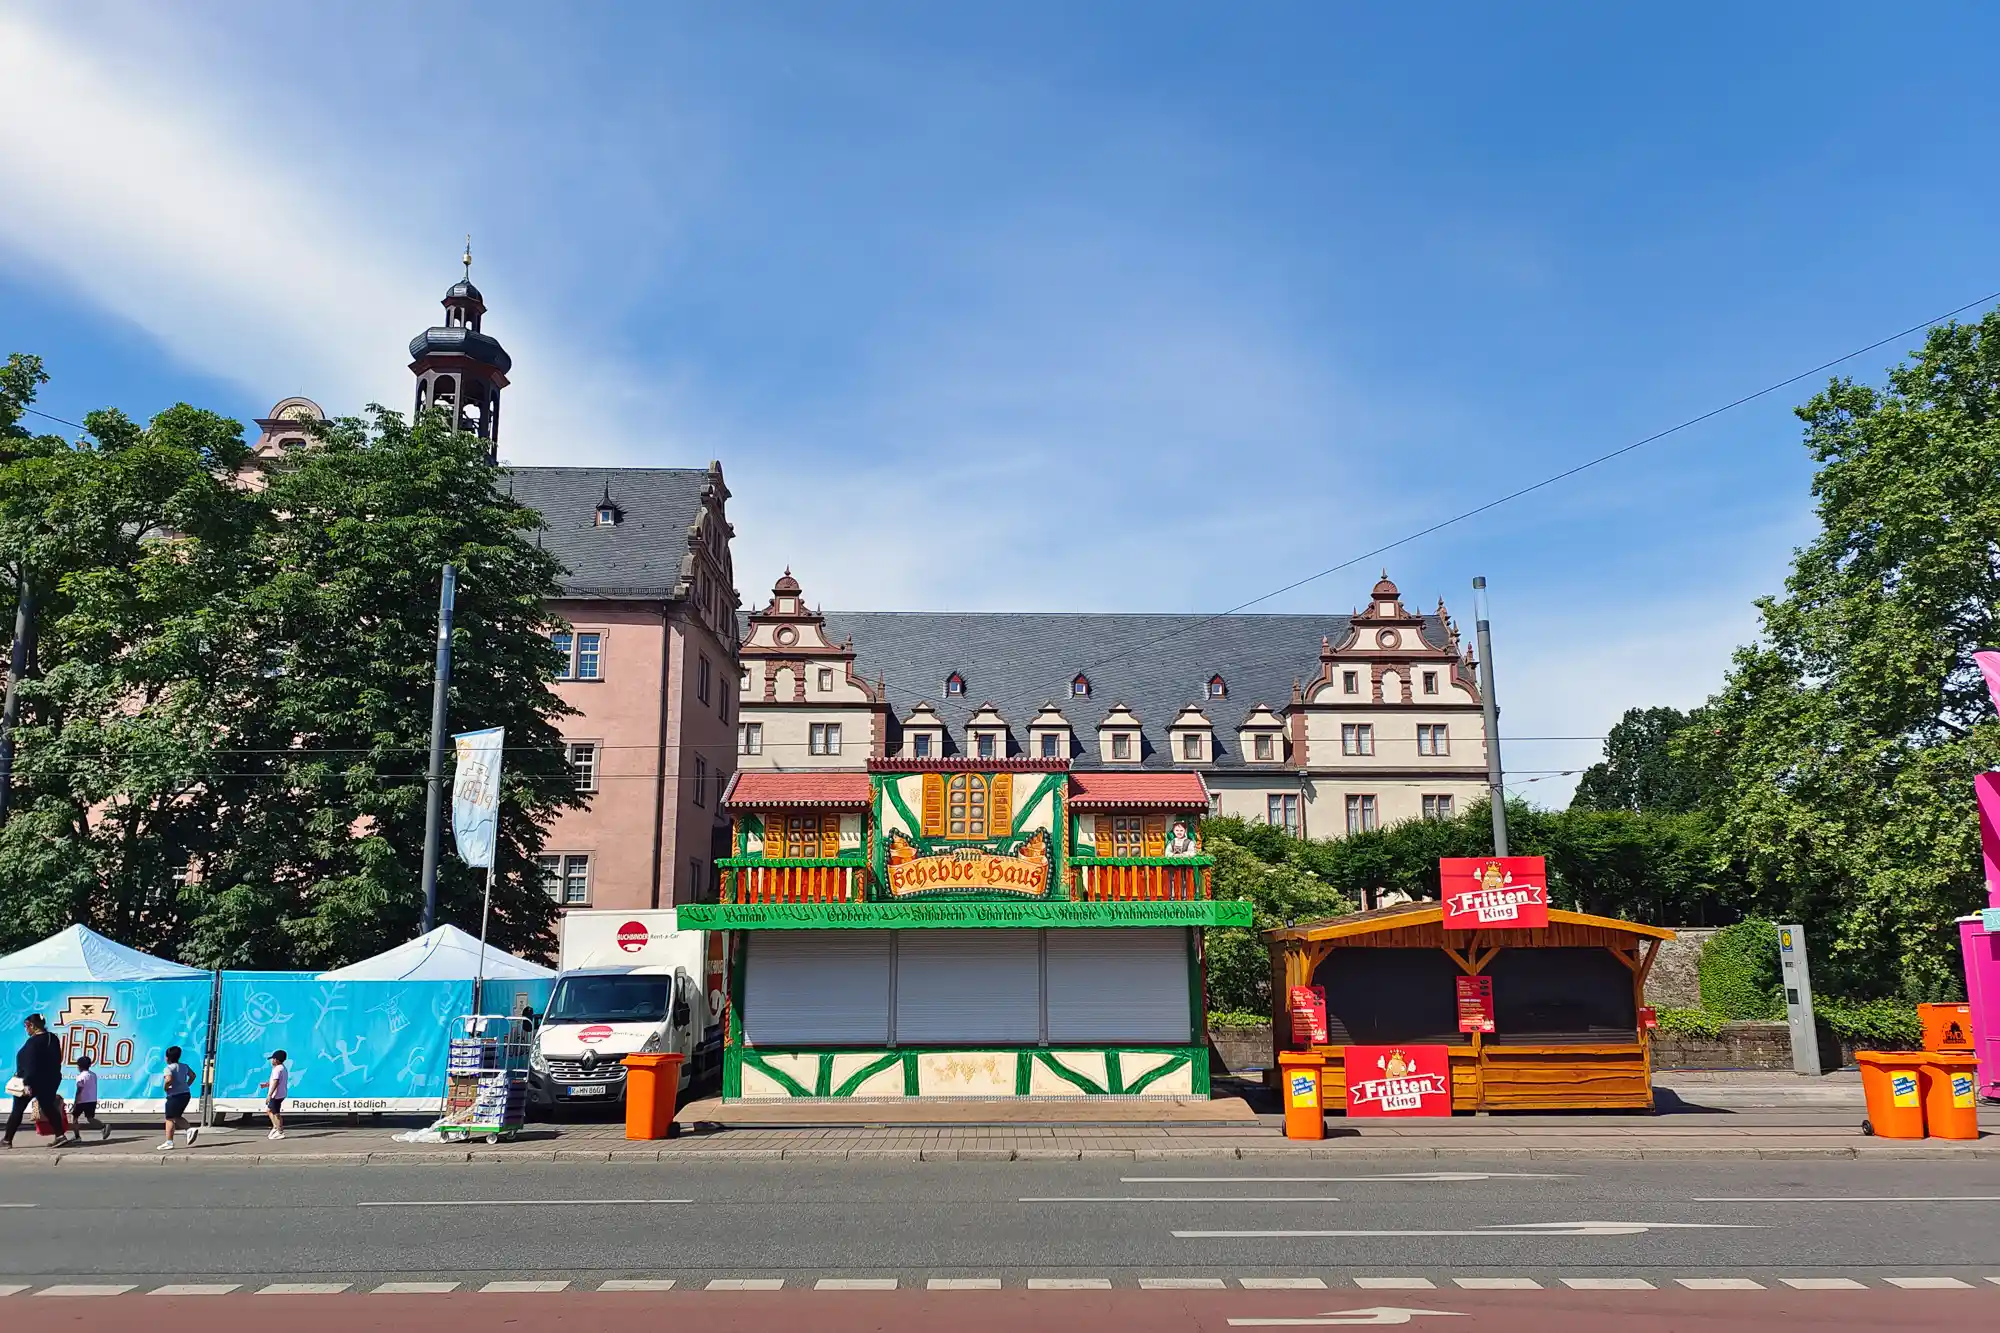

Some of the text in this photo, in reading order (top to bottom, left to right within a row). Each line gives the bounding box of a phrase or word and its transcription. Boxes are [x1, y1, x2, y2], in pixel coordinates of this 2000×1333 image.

[955, 851, 981, 862] zum
[981, 858, 1044, 887] Haus
[1461, 889, 1529, 910] Fritten
[724, 908, 767, 923] Banane
[827, 909, 872, 922] Erdbeere
[1483, 907, 1513, 919] King
[1364, 1078, 1432, 1099] Fritten
[96, 1100, 124, 1109] ödlich
[292, 1099, 387, 1108] Rauchen ist tödlich
[1387, 1096, 1416, 1108] King
